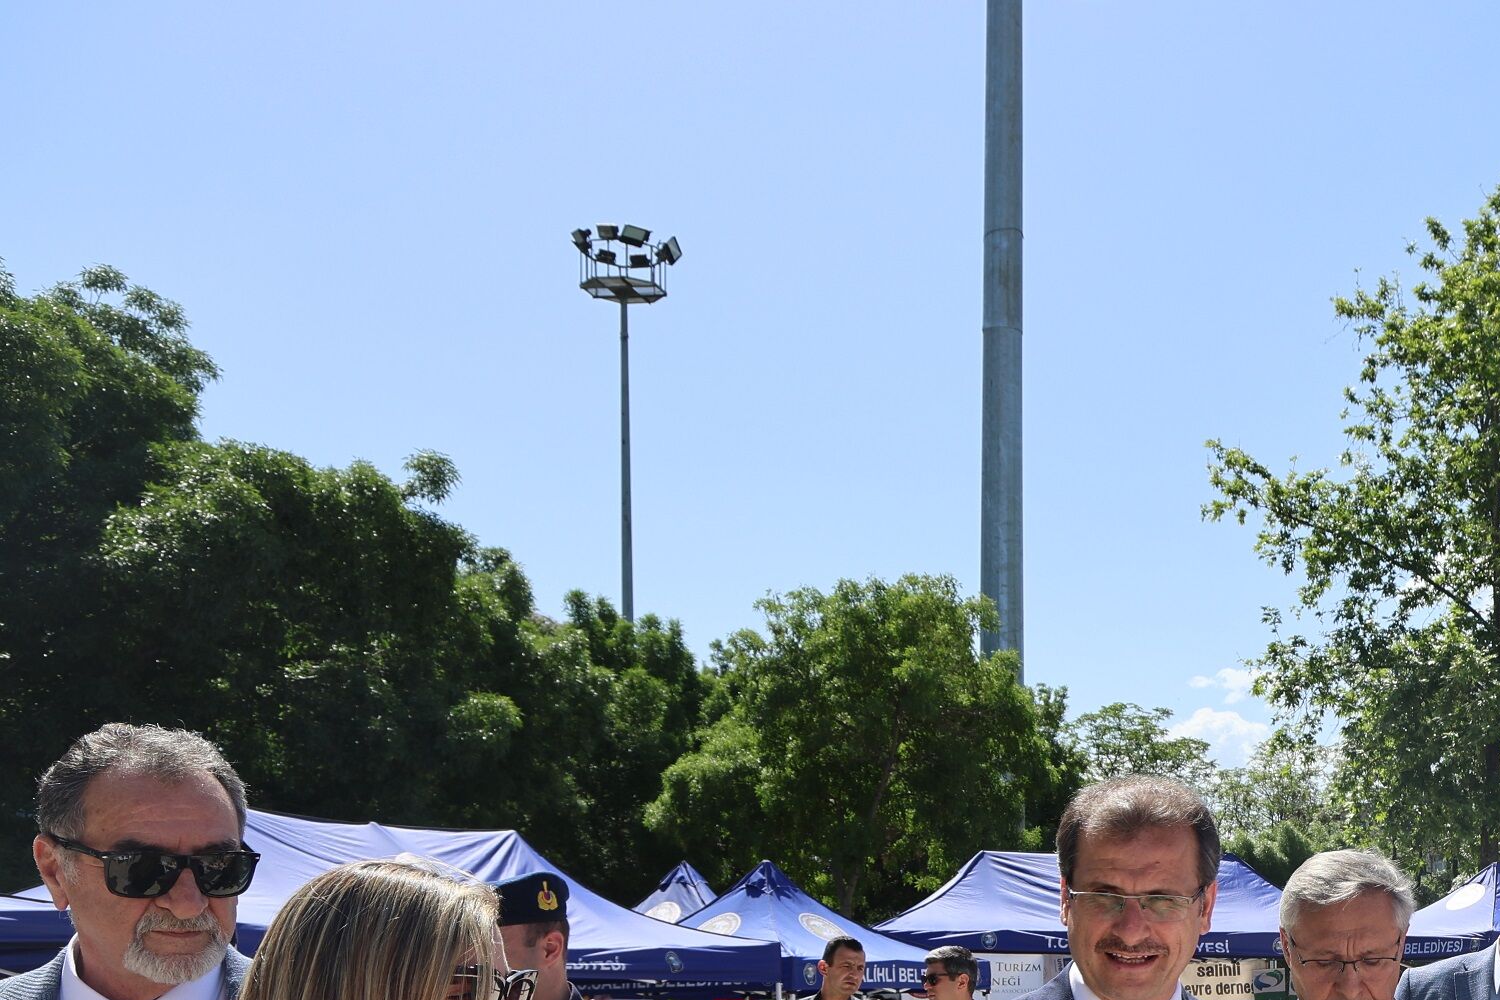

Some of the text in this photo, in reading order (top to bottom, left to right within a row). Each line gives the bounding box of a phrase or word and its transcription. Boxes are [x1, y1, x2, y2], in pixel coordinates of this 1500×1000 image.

[1404, 938, 1464, 955] BELEDİYESİ
[1197, 961, 1240, 977] salihli
[1184, 982, 1212, 996] evre
